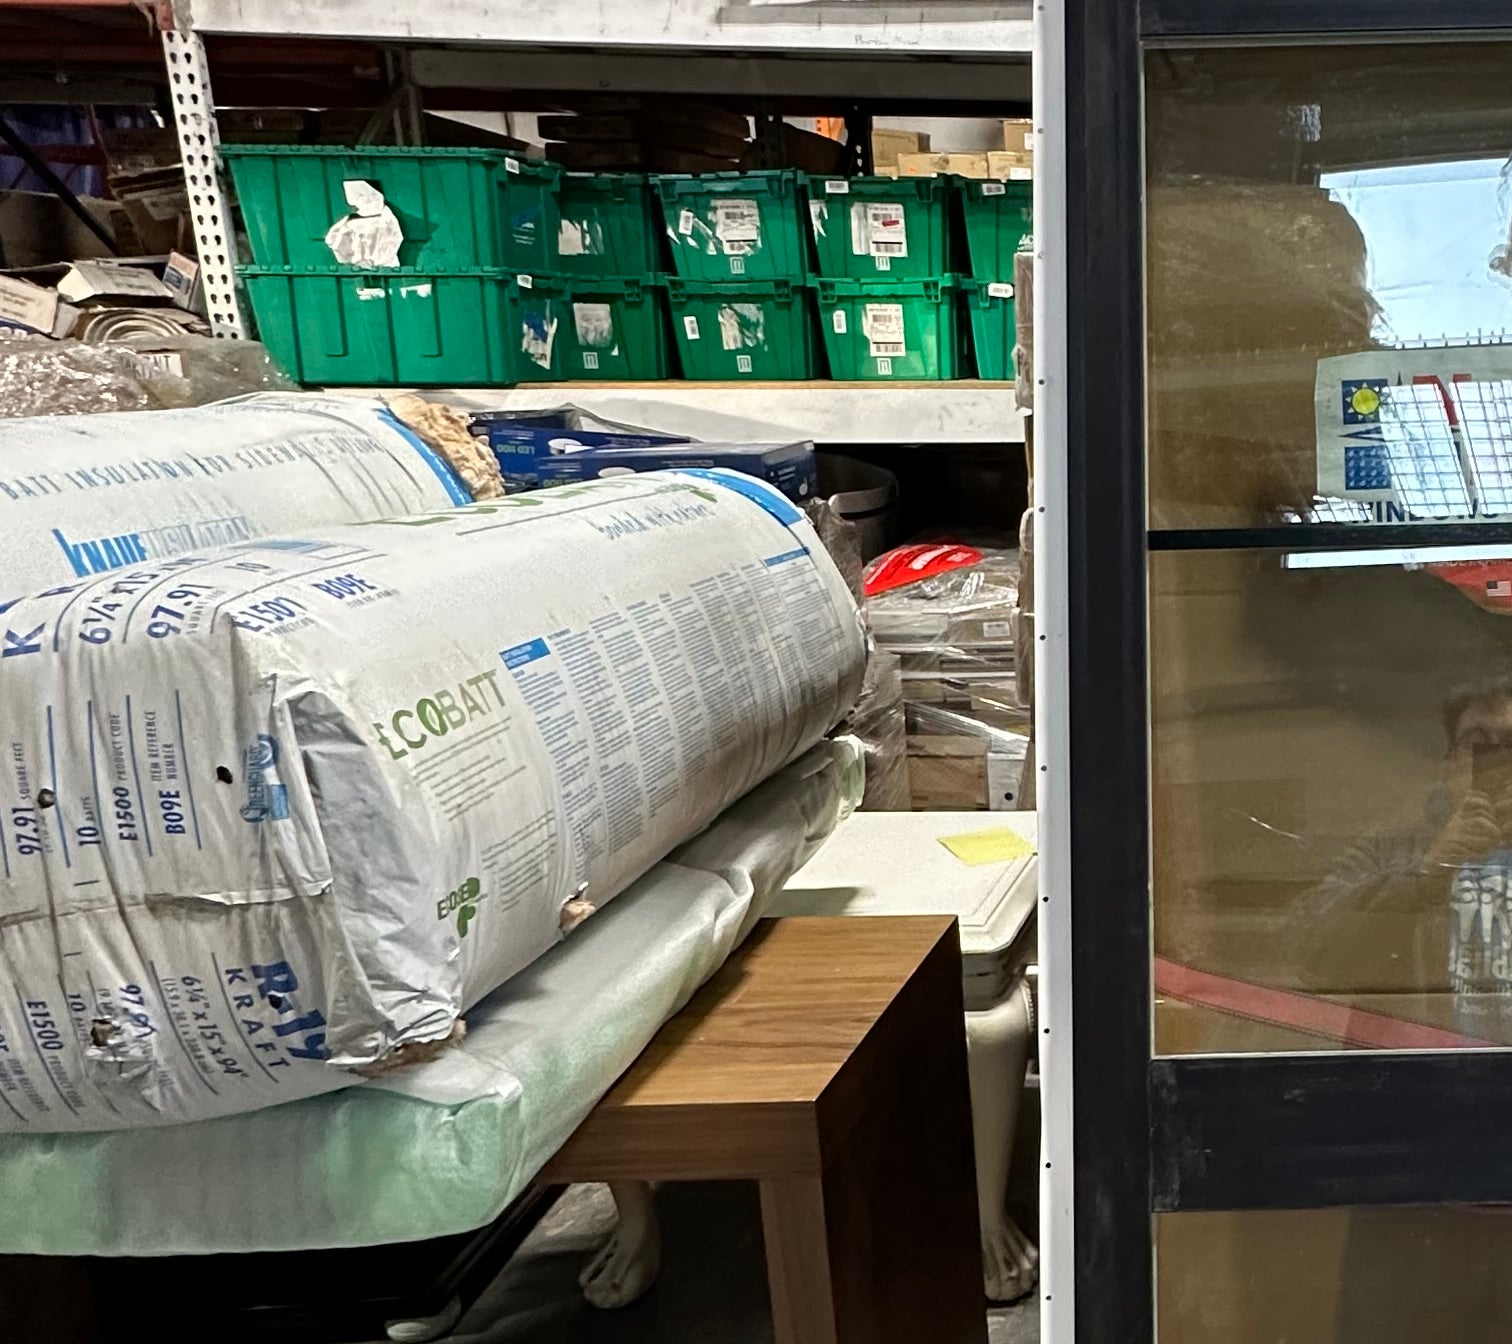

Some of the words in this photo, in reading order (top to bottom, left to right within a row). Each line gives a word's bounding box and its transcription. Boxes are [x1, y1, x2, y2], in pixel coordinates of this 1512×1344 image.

[66, 458, 192, 491] INSULATION
[52, 529, 147, 579] KNAUF
[147, 583, 216, 639] 97.91
[372, 668, 506, 760] ECOBATT
[13, 807, 42, 855] 97.91
[76, 826, 101, 847] 10
[113, 786, 138, 842] E1500
[158, 790, 187, 836] B09E
[26, 1000, 64, 1051] E1500
[67, 992, 86, 1013] 10
[225, 967, 290, 1069] KRAFT
